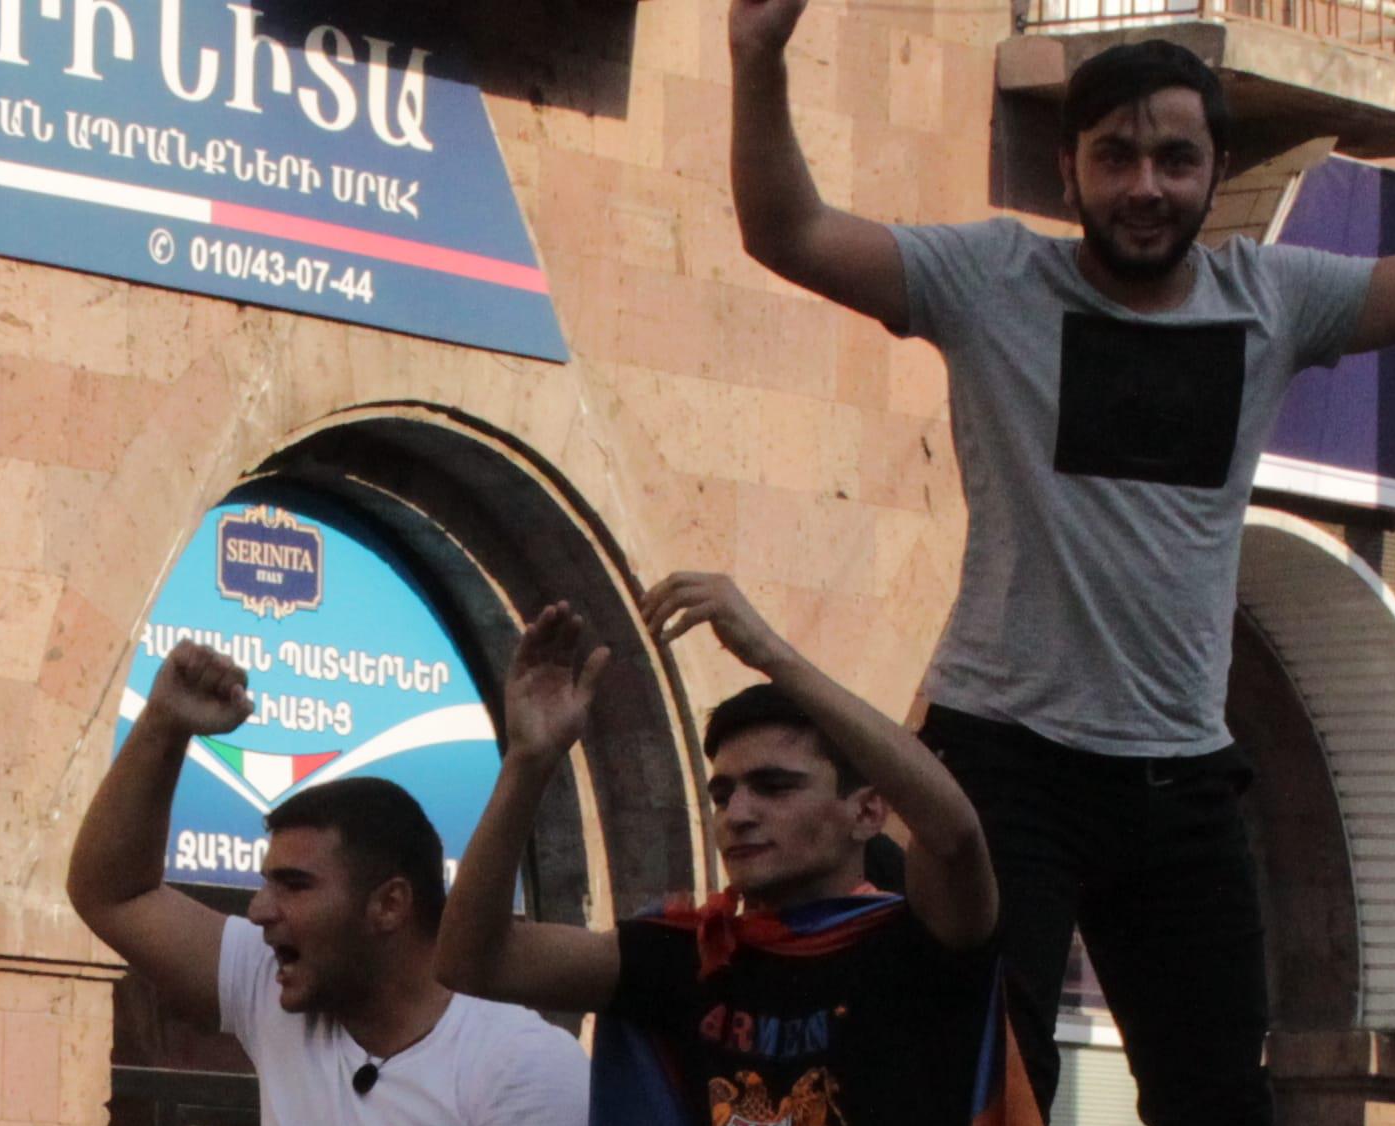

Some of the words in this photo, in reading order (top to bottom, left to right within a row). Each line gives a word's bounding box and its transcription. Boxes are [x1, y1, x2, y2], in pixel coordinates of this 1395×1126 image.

[65, 110, 321, 193] ԱՊՐԱՆՔՆԵՐԻ
[332, 165, 420, 220] ՍՐԱՀ
[190, 236, 373, 303] 010/43-07-44
[226, 537, 314, 574] SERINITA
[256, 569, 285, 585] ITALY
[279, 640, 449, 695] ՊԱՏՎԵՐՆԵՐ
